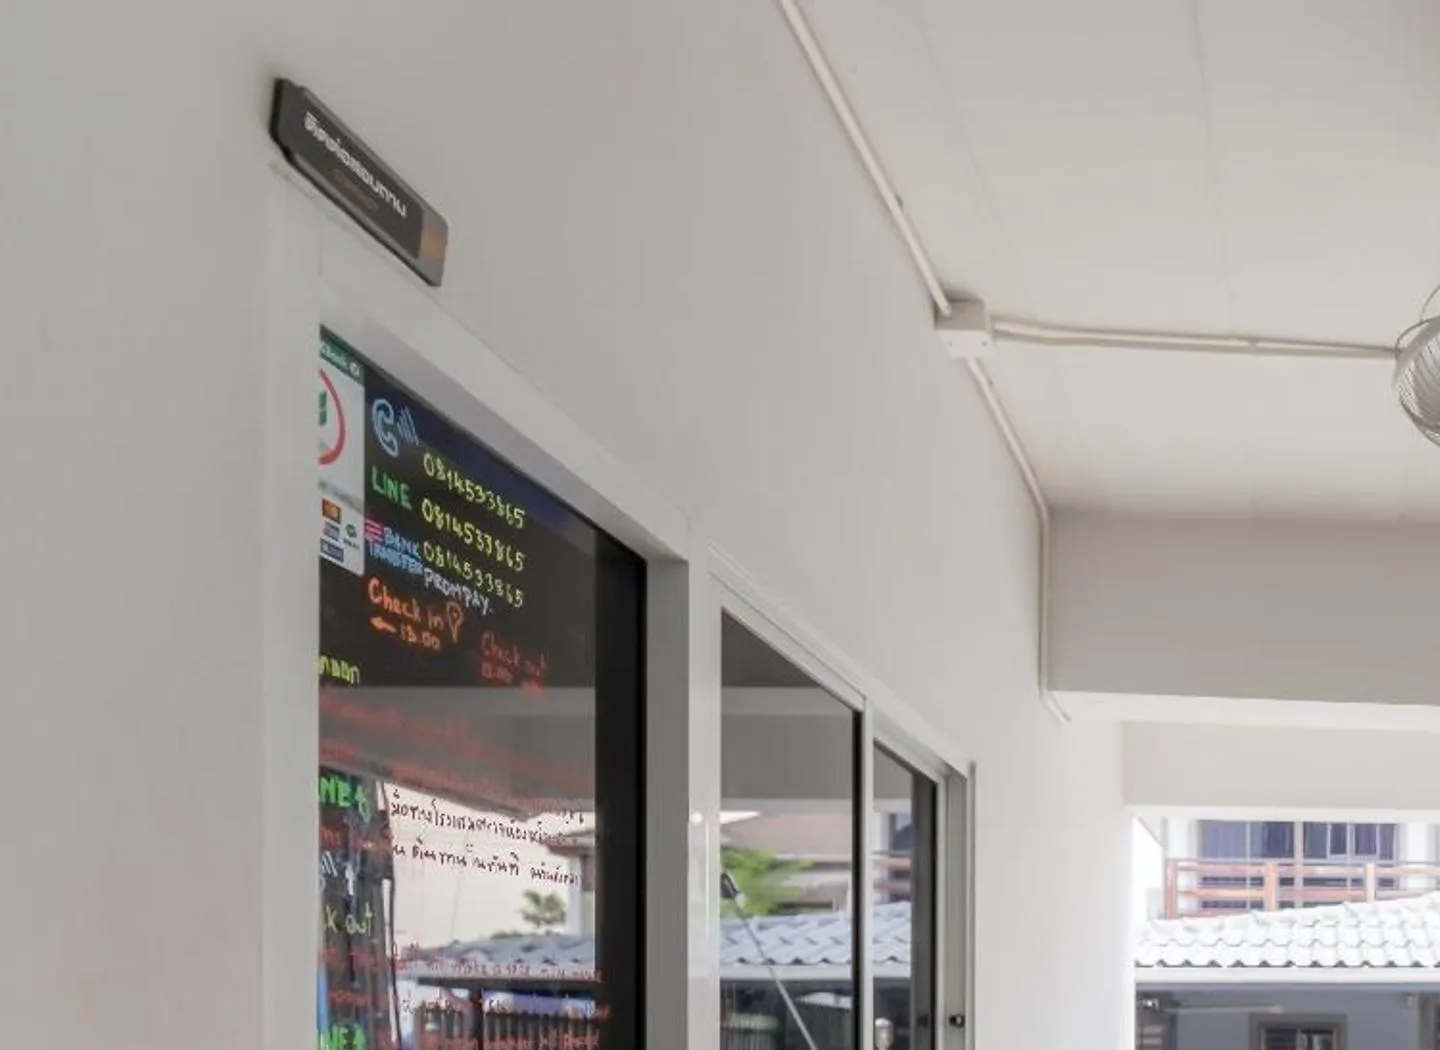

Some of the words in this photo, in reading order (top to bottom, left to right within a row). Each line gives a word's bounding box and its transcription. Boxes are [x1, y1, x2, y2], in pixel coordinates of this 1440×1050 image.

[371, 466, 412, 510] LINE
[421, 499, 525, 571] 0814533865
[423, 453, 525, 529] 0814533865
[368, 576, 421, 622] Check
